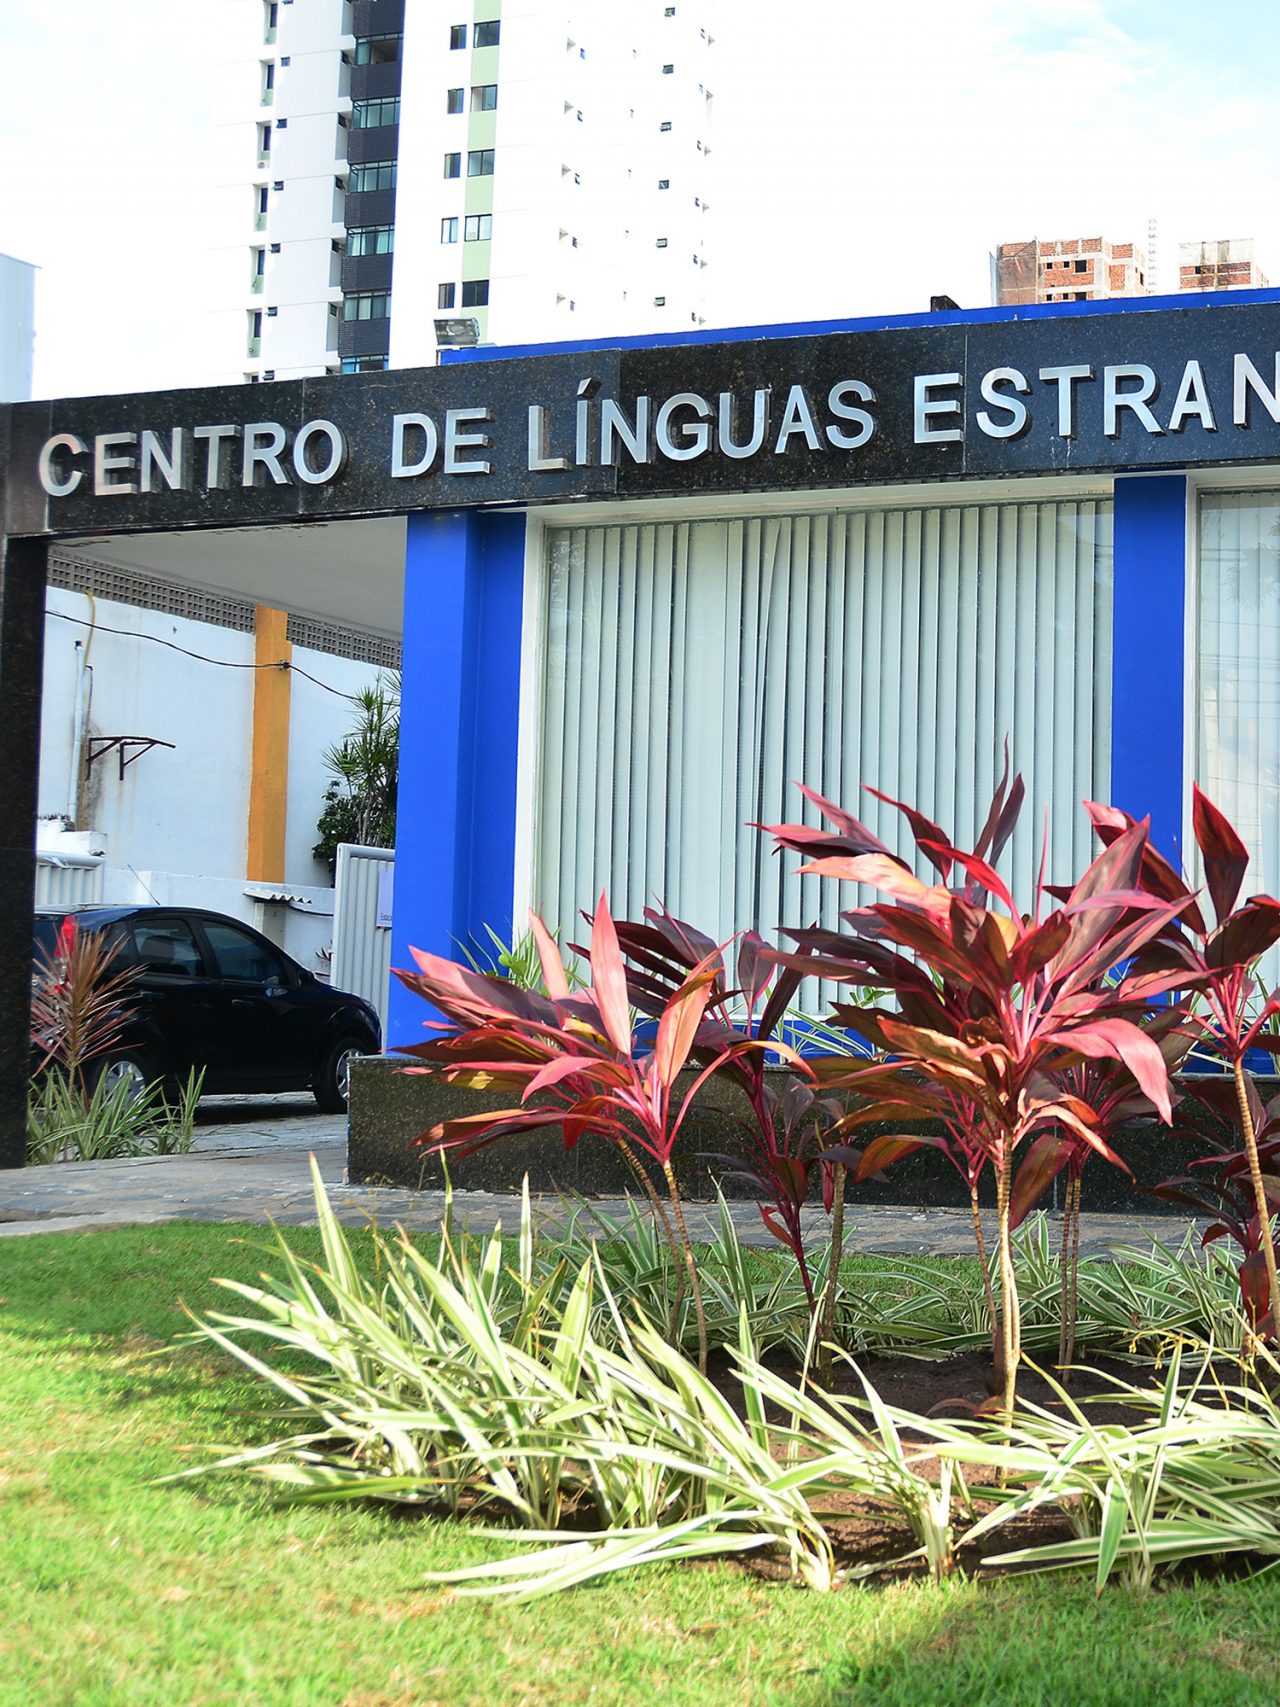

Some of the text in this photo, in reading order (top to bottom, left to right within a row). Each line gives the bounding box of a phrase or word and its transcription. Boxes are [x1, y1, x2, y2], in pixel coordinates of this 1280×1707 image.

[37, 418, 350, 498] CENTRO
[390, 406, 492, 479] DE
[526, 377, 879, 473] LÍNGUAS
